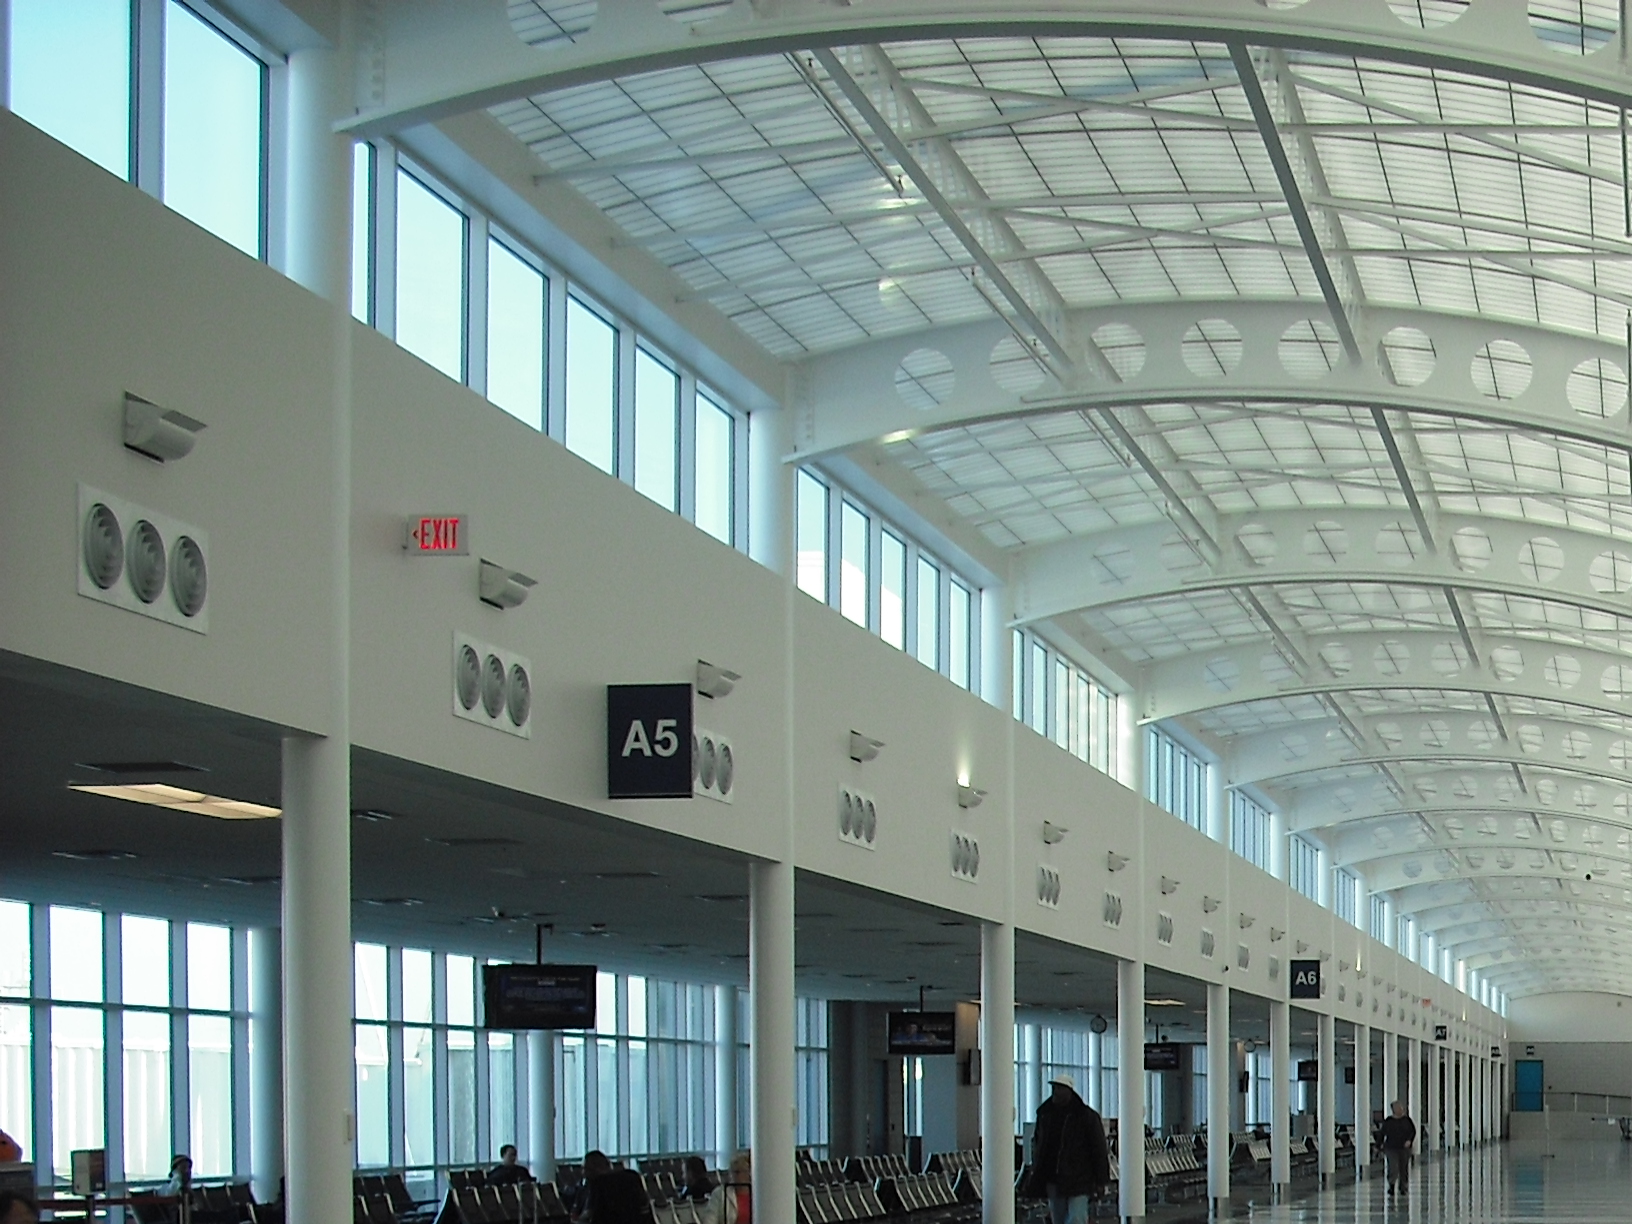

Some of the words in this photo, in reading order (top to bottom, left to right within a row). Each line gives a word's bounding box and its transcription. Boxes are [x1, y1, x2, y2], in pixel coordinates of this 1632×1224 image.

[420, 518, 459, 549] EXIT
[622, 719, 679, 757] A5
[1295, 971, 1317, 985] A6
